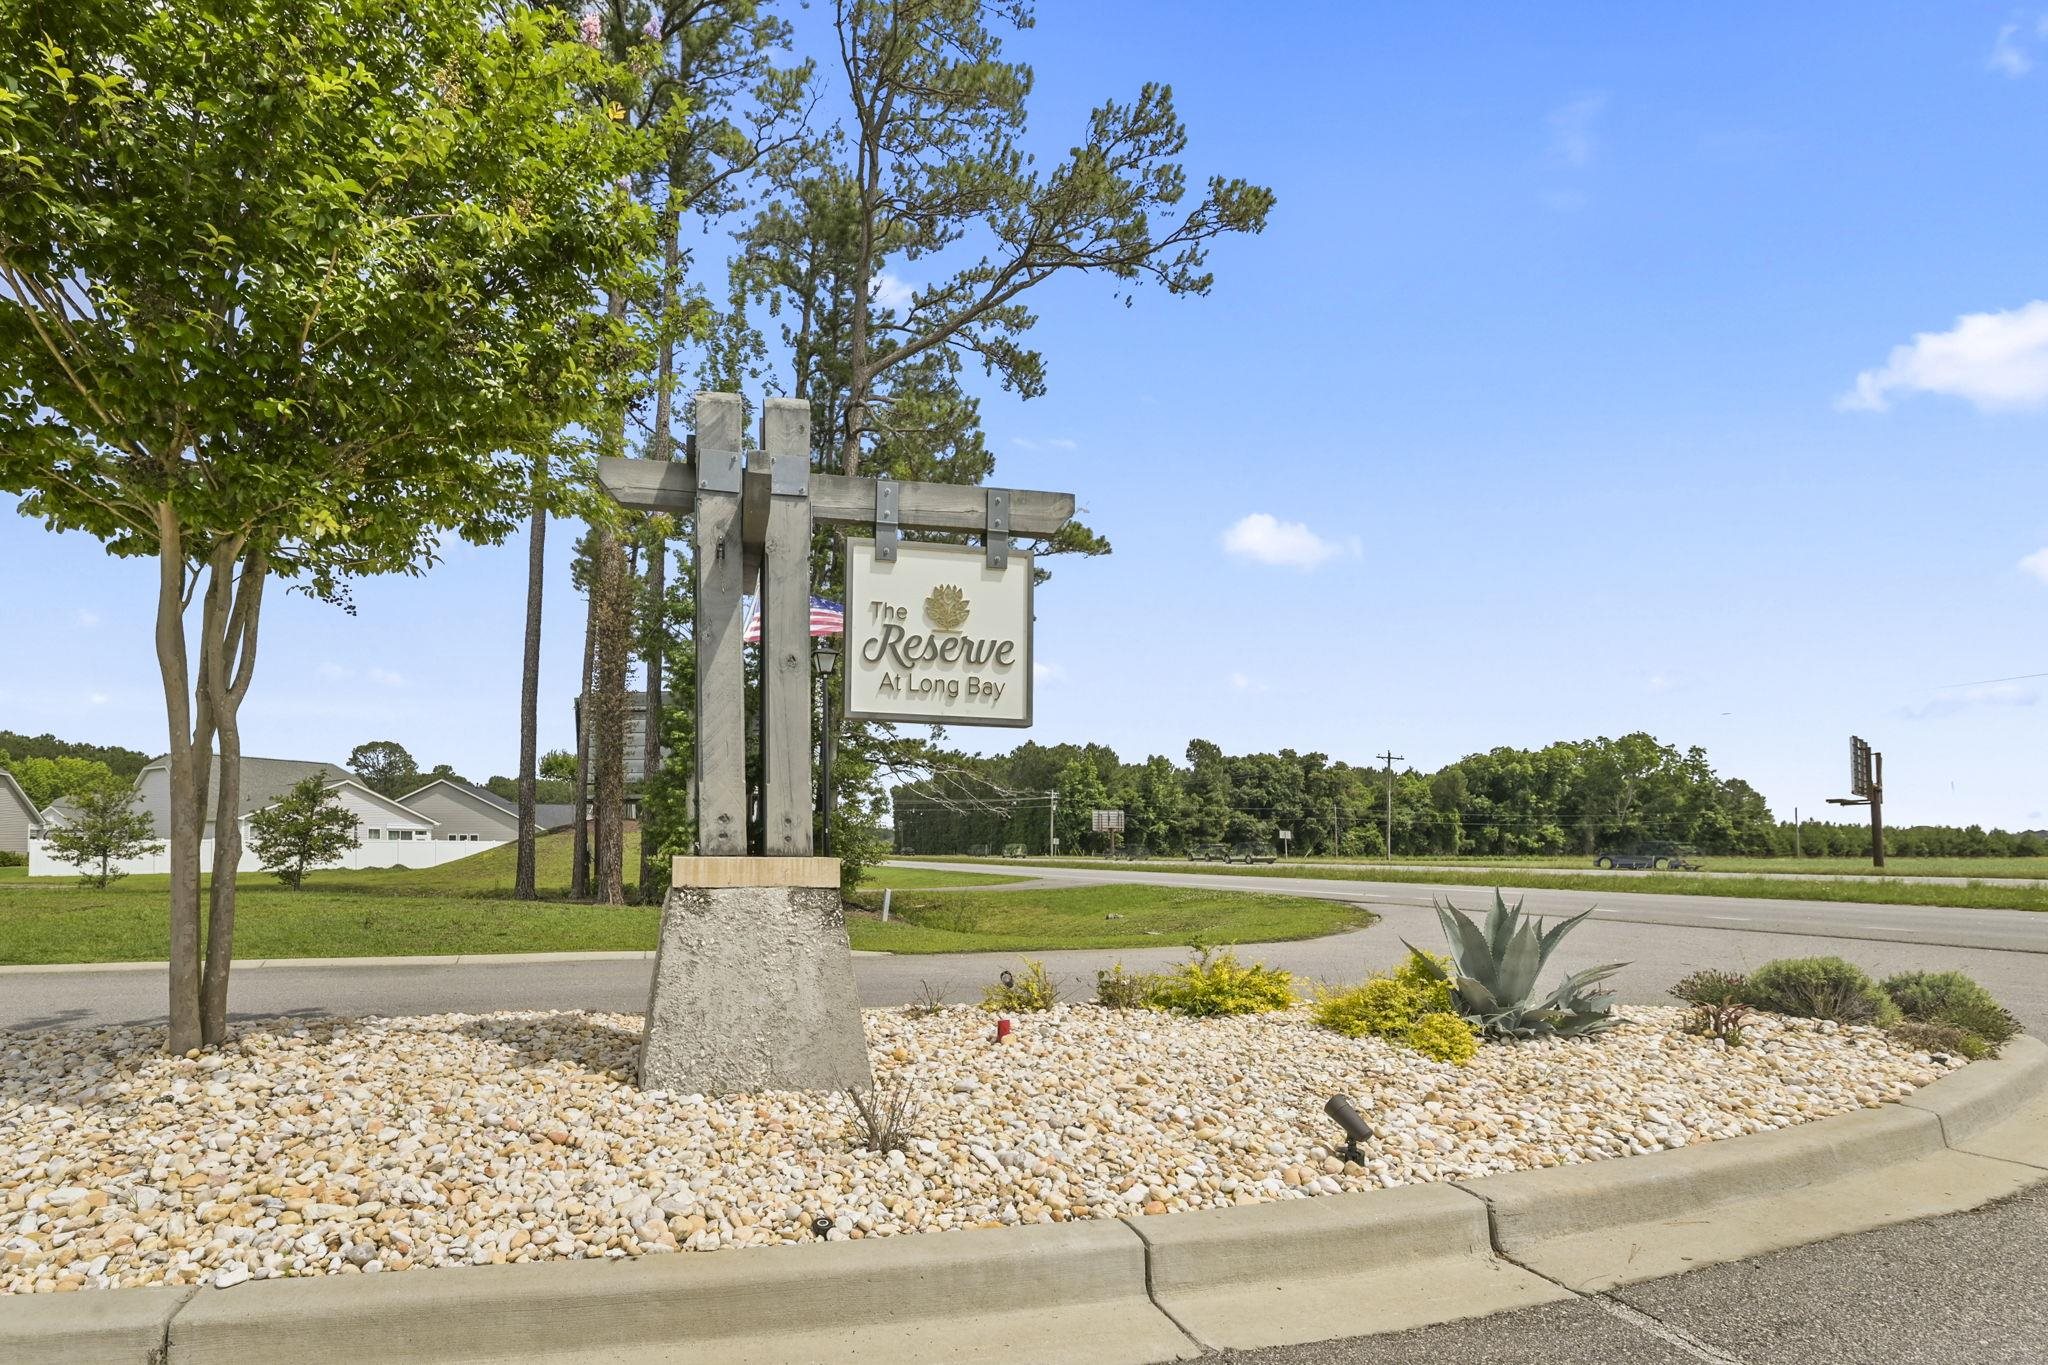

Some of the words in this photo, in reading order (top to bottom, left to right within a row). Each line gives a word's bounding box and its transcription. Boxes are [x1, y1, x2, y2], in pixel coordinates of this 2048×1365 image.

[871, 600, 908, 620] The
[863, 623, 1016, 669] Reserve
[879, 671, 902, 692] At
[908, 673, 960, 698] Long
[968, 676, 1006, 701] Bay
